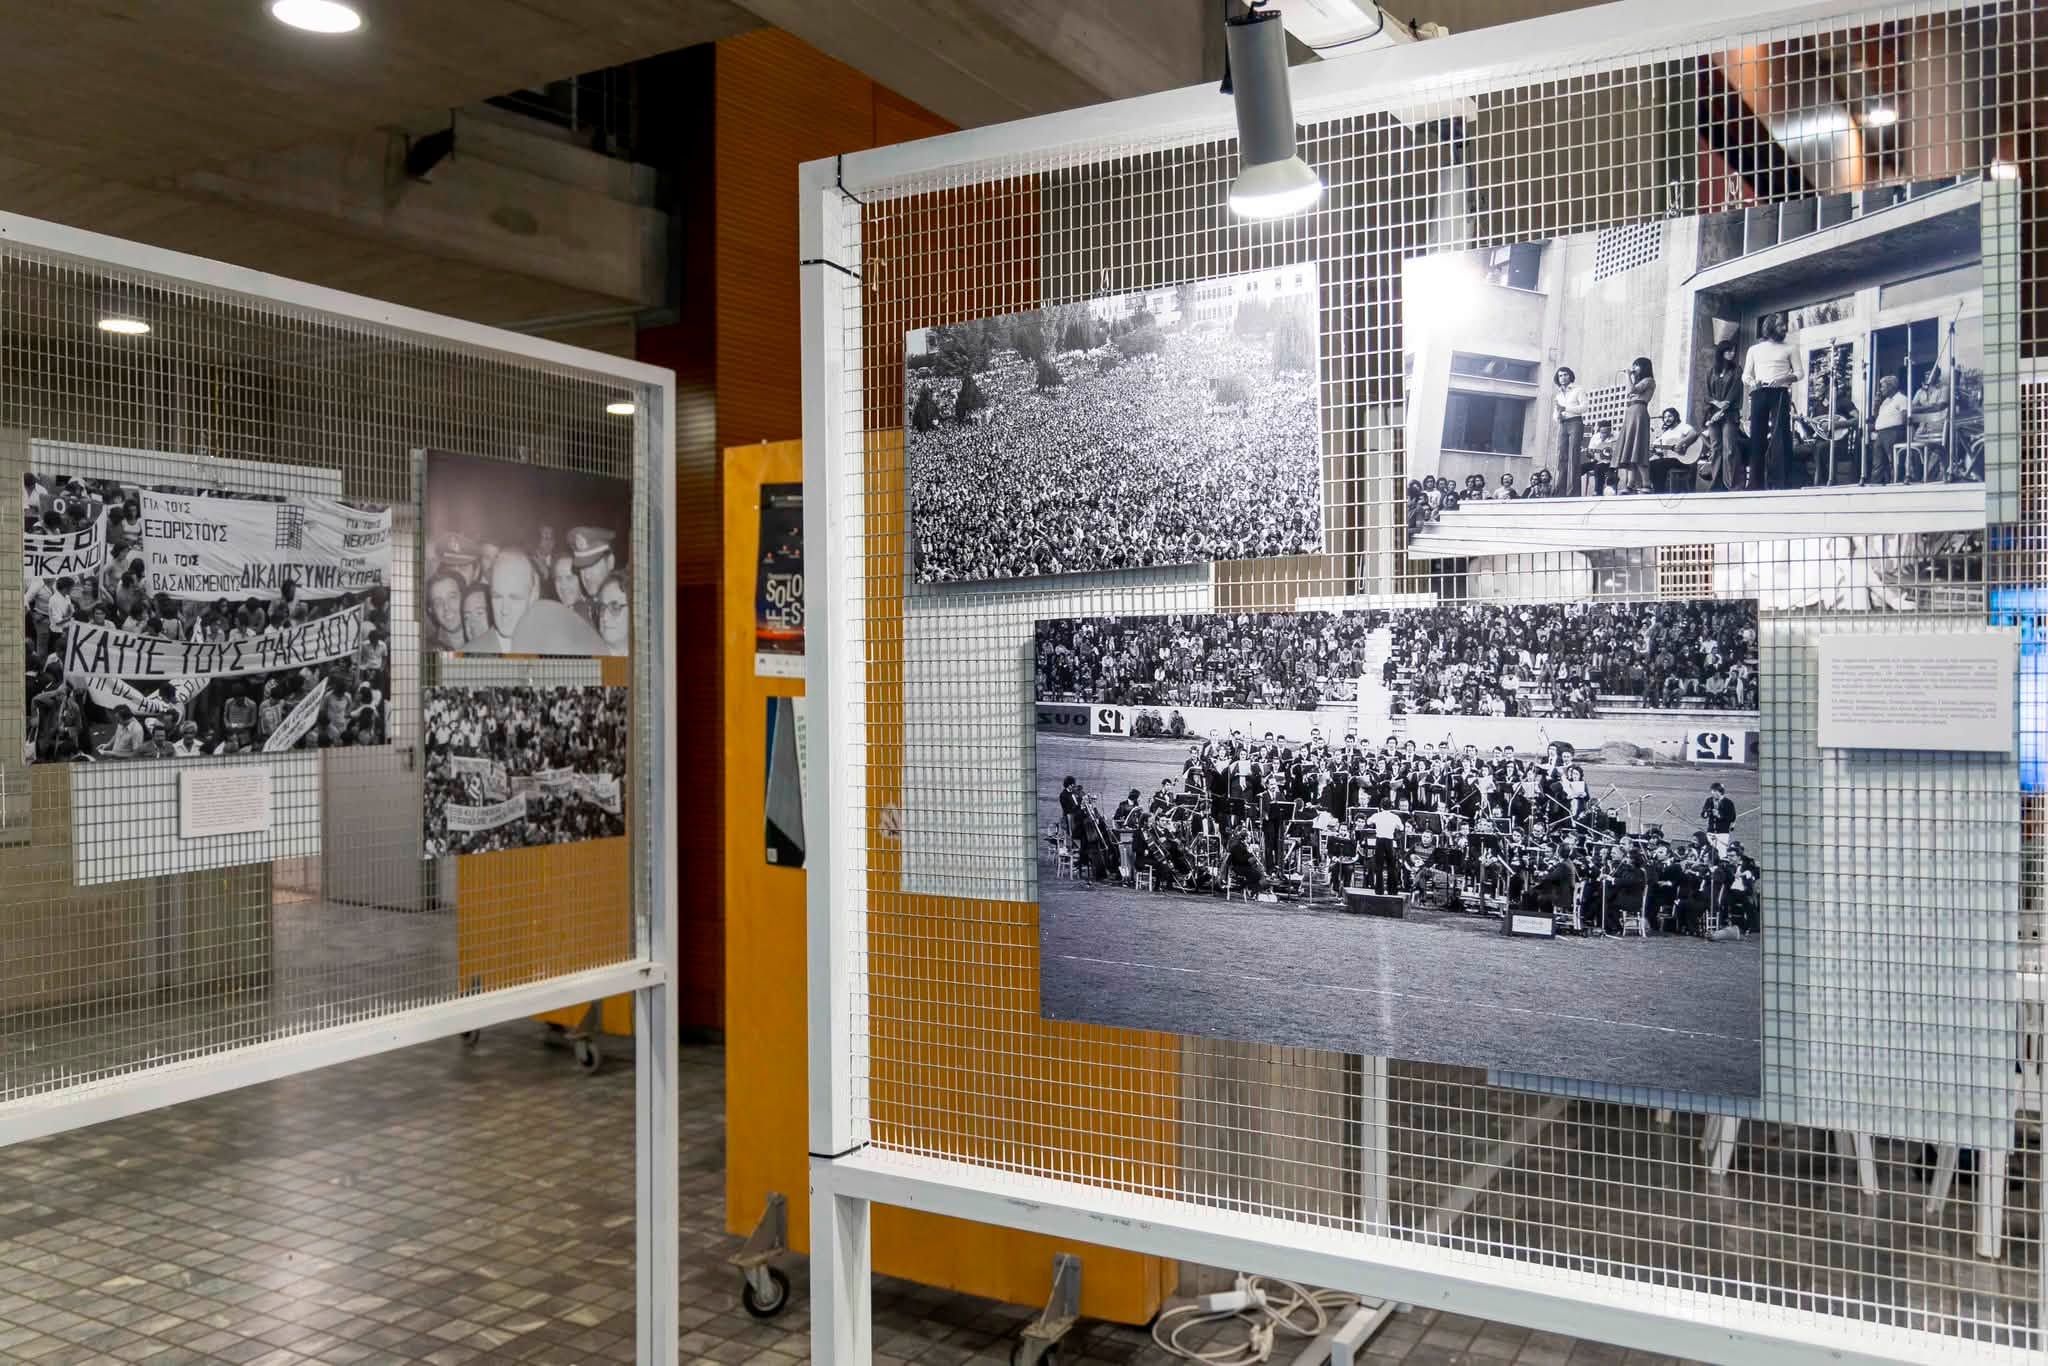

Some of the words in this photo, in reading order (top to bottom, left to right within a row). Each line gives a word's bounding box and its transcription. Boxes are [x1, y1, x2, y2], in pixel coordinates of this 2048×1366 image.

[143, 497, 159, 511] ΓΙΑ
[164, 500, 192, 514] ΤΟΥΣ
[144, 518, 228, 543] ΕΞΟΡΙΣΤΟΥΣ
[153, 552, 168, 566] ΓΙΑ
[152, 573, 241, 593] ΒΑΣΑΝΙΣΜΕΝΟΥΣ
[241, 562, 337, 589] ΔΙΚΑΙΟΣΥΝΗ
[766, 574, 802, 608] SOLO
[69, 623, 173, 675] ΚΑΨΤΕ
[181, 640, 249, 675] ΤΟΥΣ
[256, 606, 362, 668] ΦΑΚΕΛΟΥΣ
